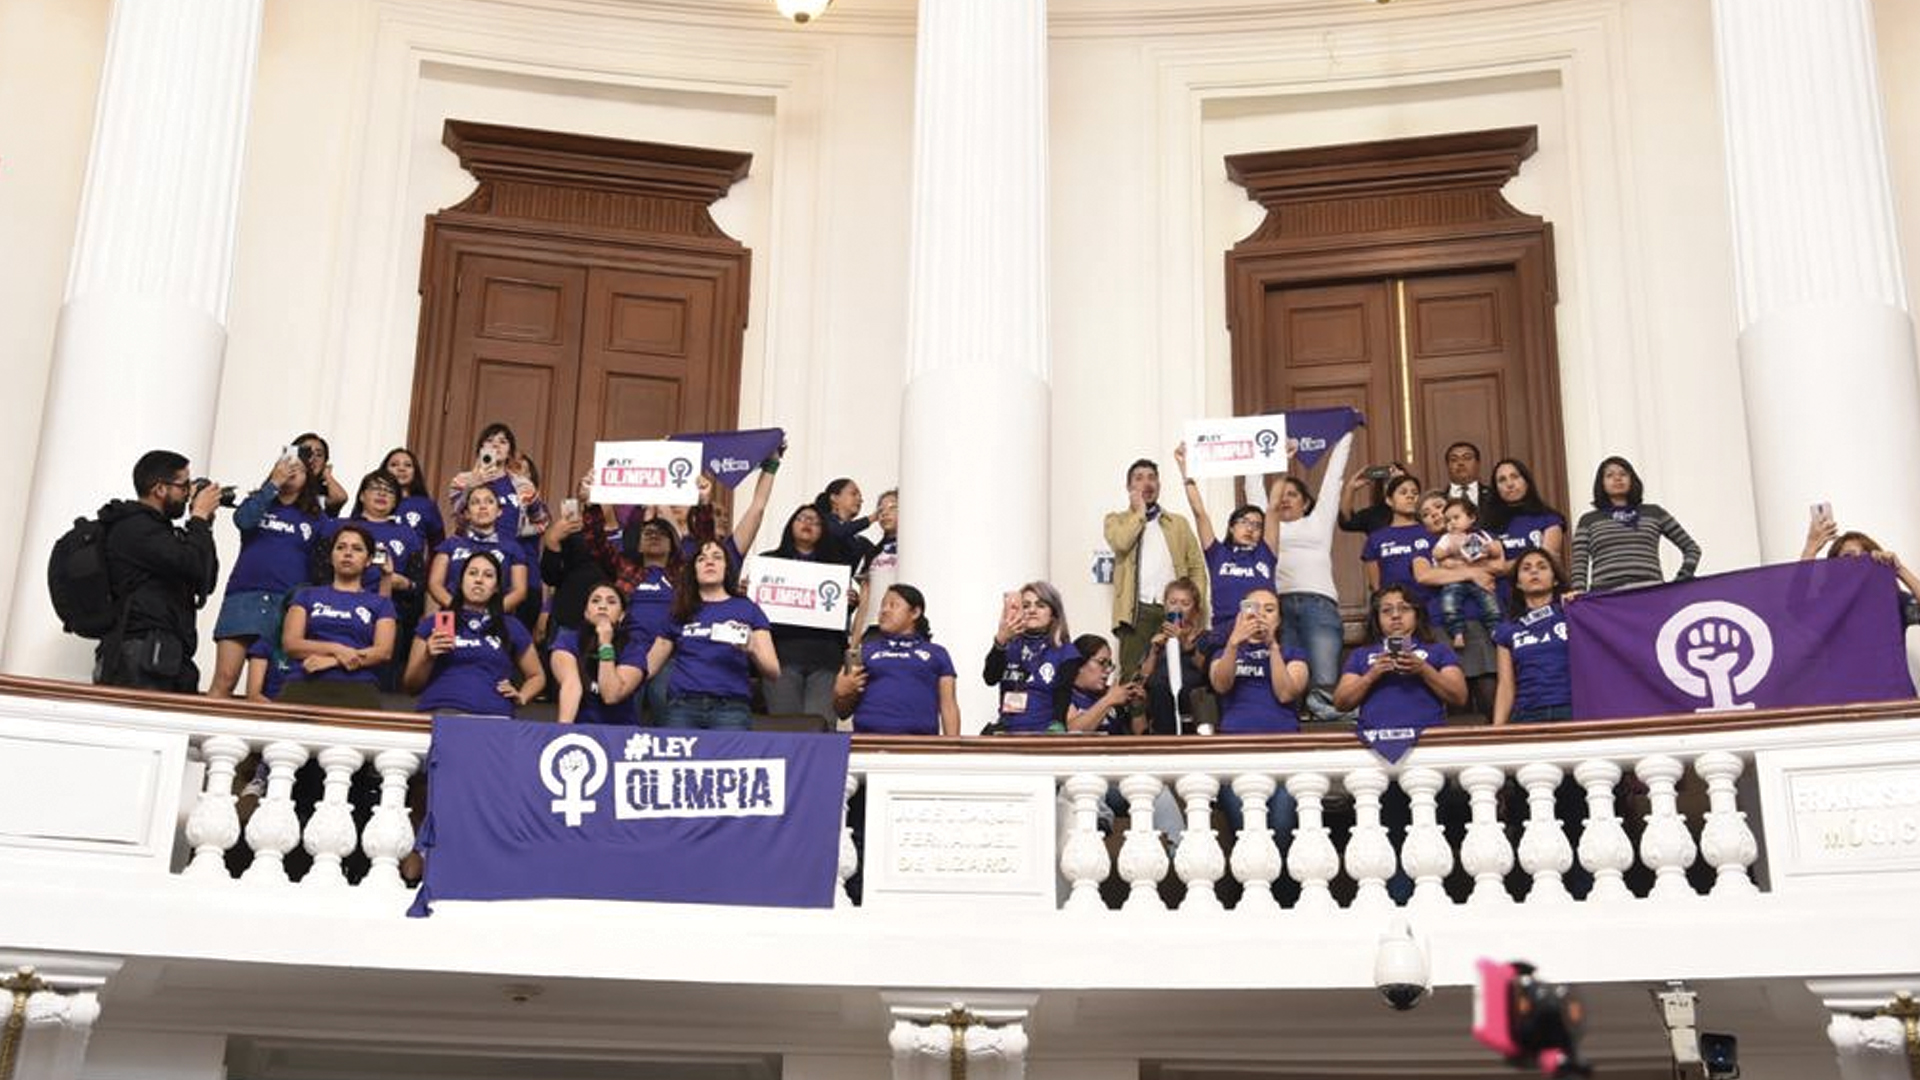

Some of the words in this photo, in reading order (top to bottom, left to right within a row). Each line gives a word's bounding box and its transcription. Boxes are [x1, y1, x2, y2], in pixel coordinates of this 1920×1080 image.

[606, 457, 632, 467] #LEY
[604, 469, 662, 486] OLIMPIA
[758, 584, 813, 609] OLIMPIA
[624, 732, 698, 760] #LEY
[626, 767, 772, 811] OLIMPIA
